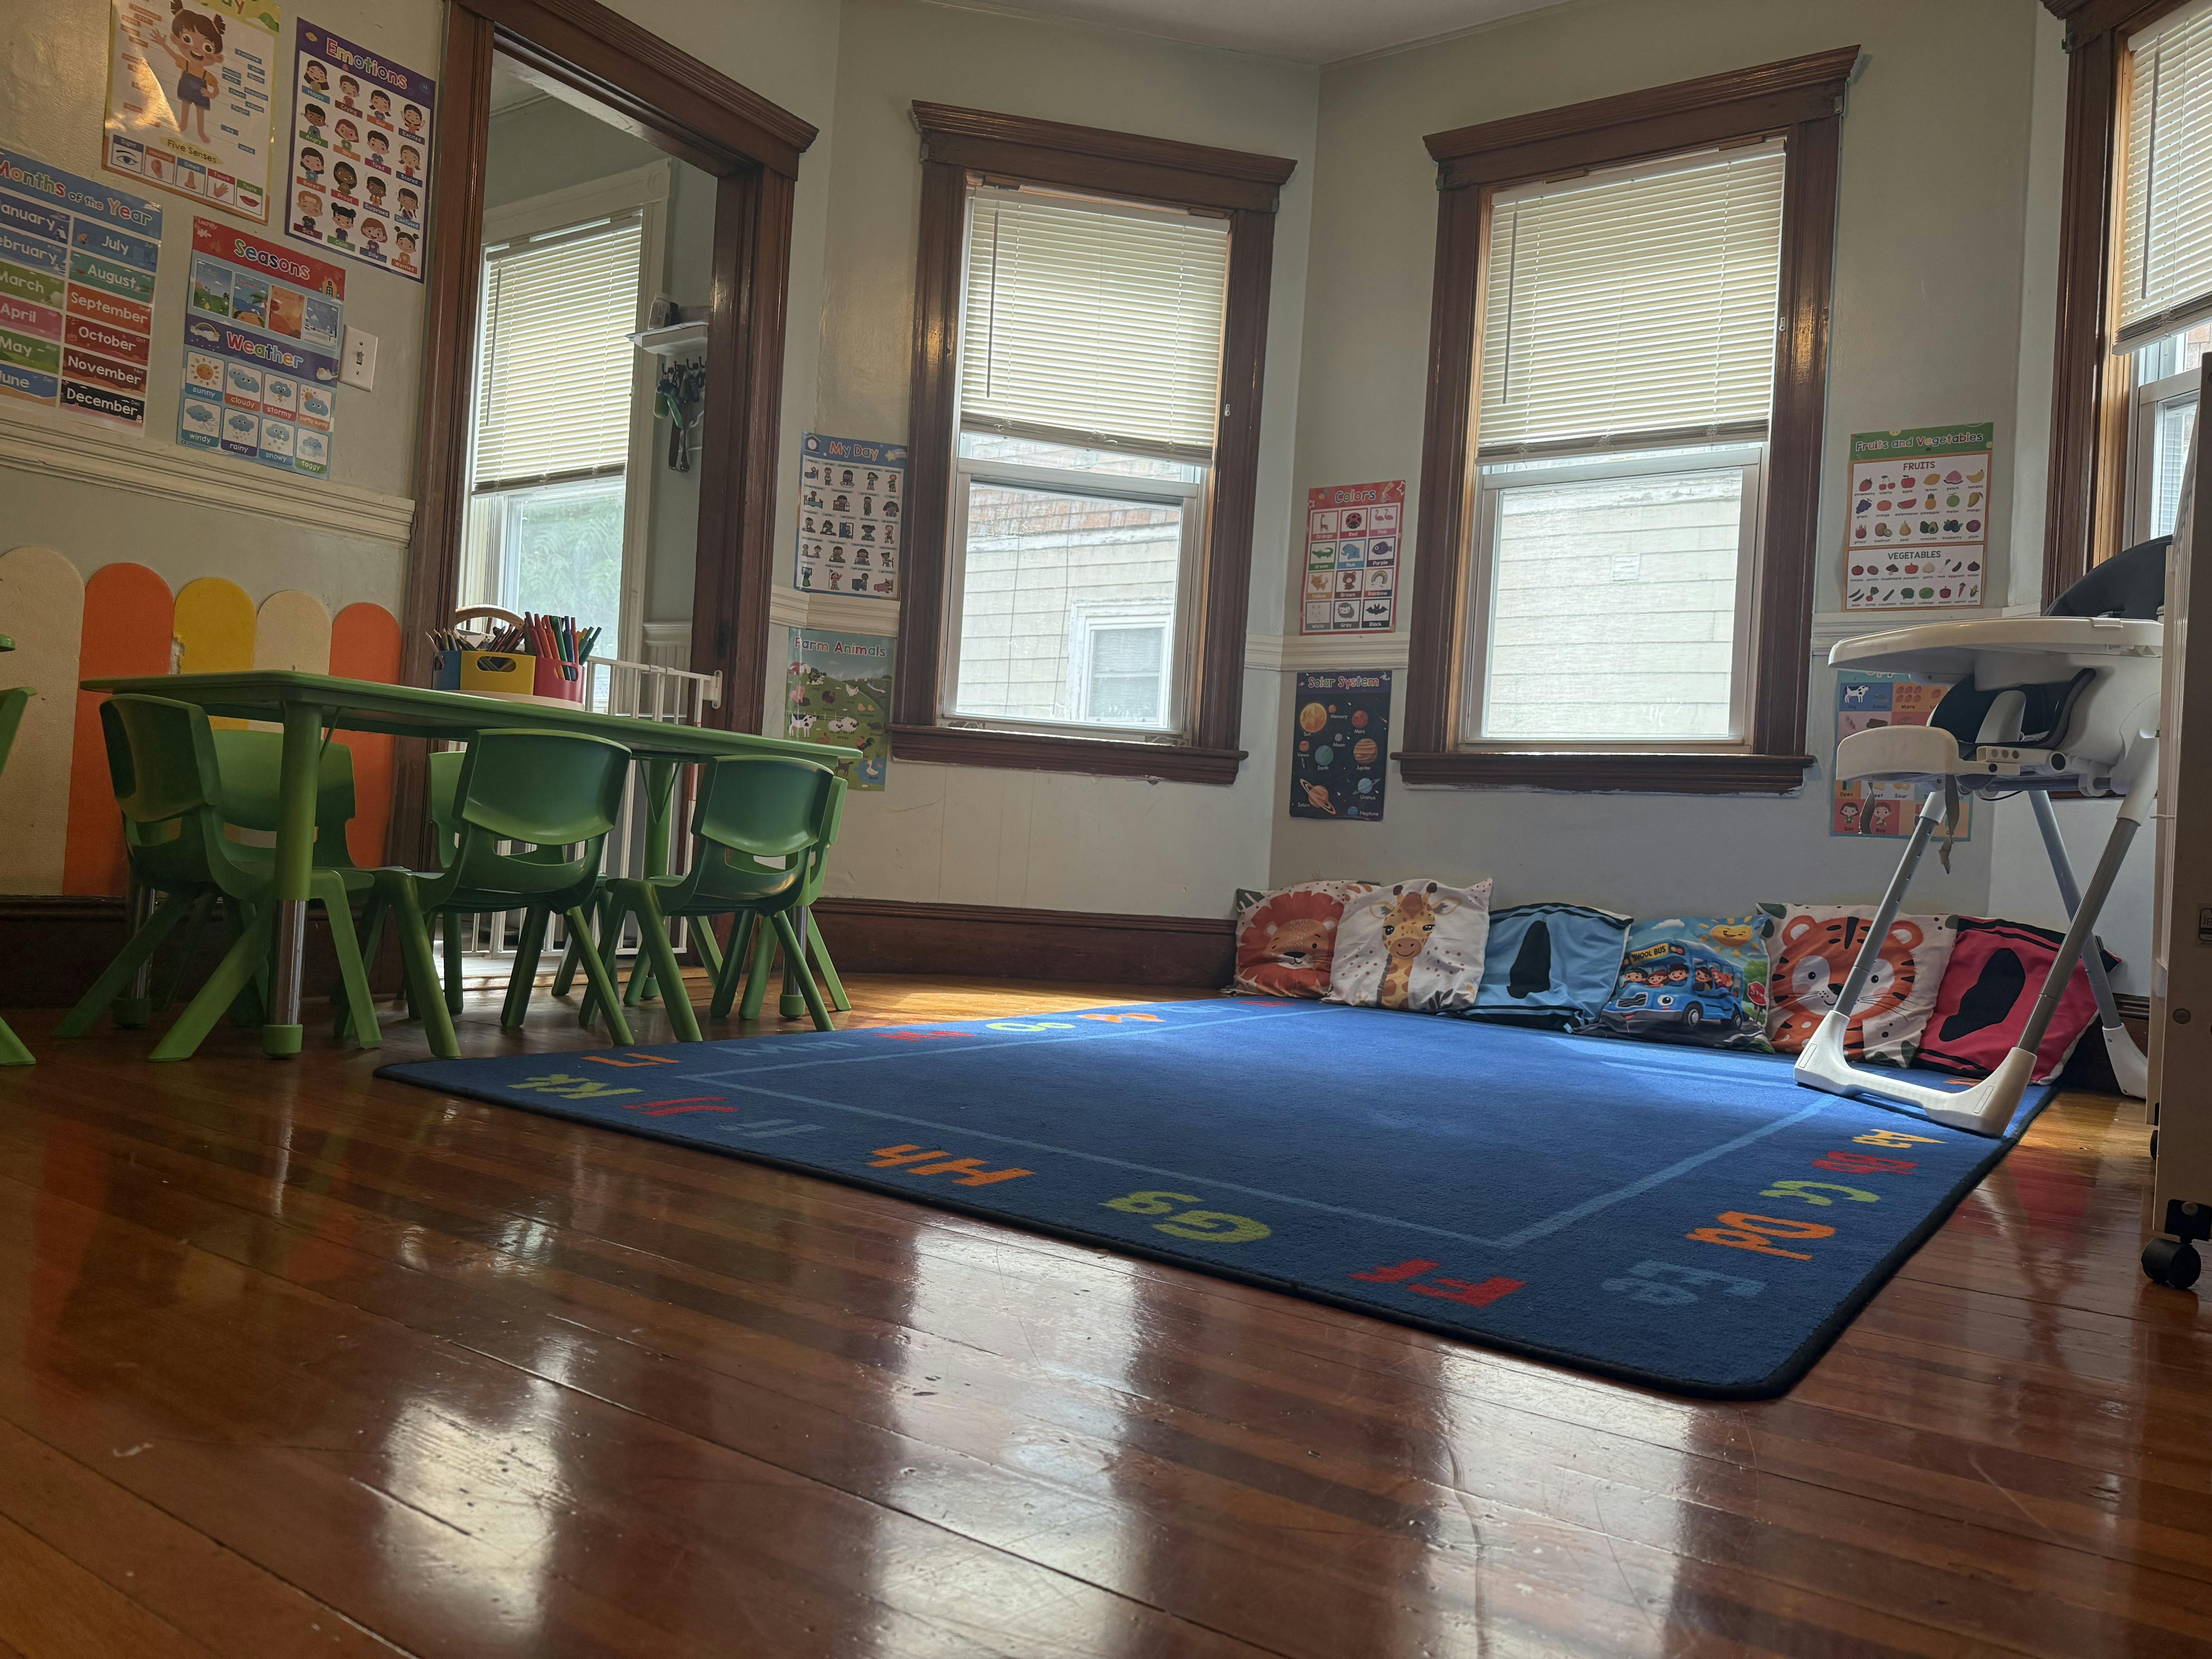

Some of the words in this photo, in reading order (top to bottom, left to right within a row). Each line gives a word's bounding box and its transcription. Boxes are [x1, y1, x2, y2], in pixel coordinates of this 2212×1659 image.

[326, 38, 407, 89] Emotions
[307, 89, 325, 101] Happy
[341, 104, 358, 116] Crying
[306, 134, 322, 145] Angry
[402, 131, 421, 142] Excited
[168, 139, 186, 152] Five
[188, 147, 217, 163] Senses
[372, 161, 385, 170] Tired
[213, 171, 230, 182] Touch
[400, 173, 418, 184] Scared
[303, 179, 319, 190] Bored
[337, 193, 353, 203] Proud
[0, 200, 56, 231] anuary
[67, 192, 83, 203] of
[84, 196, 104, 211] the
[107, 197, 153, 227] Year
[364, 203, 388, 216] Surprised
[302, 227, 314, 236] Sick
[101, 235, 130, 256] July
[335, 240, 348, 248] Calm
[234, 239, 311, 281] Seasons
[368, 251, 379, 260] Silly
[87, 264, 137, 289] August
[238, 278, 261, 291] Summer
[273, 290, 296, 302] Autumn
[0, 302, 36, 323] April
[70, 292, 149, 324] September
[78, 326, 136, 352] October
[0, 336, 33, 357] May
[227, 331, 304, 369] Weather
[67, 355, 142, 385] November
[192, 386, 216, 398] sunny
[66, 387, 138, 416] December
[231, 397, 255, 409] cloudy
[266, 406, 292, 419] stormy
[189, 433, 211, 444] windy
[1855, 439, 1889, 452] Fruits
[1891, 437, 1914, 448] and
[1916, 432, 1984, 447] Vegetables
[229, 443, 249, 453] rainy
[830, 441, 851, 458] My
[854, 444, 879, 462] Day
[265, 452, 287, 463] snowy
[301, 460, 321, 472] foggy
[1903, 461, 1936, 471] FRUITS
[1335, 489, 1376, 504] Colors
[1887, 550, 1941, 560] VEGETABLES
[794, 636, 830, 652] Farm
[834, 641, 886, 658] Animals
[1308, 676, 1336, 688] Solar
[1338, 675, 1379, 690] System
[1654, 946, 1666, 955] BUS
